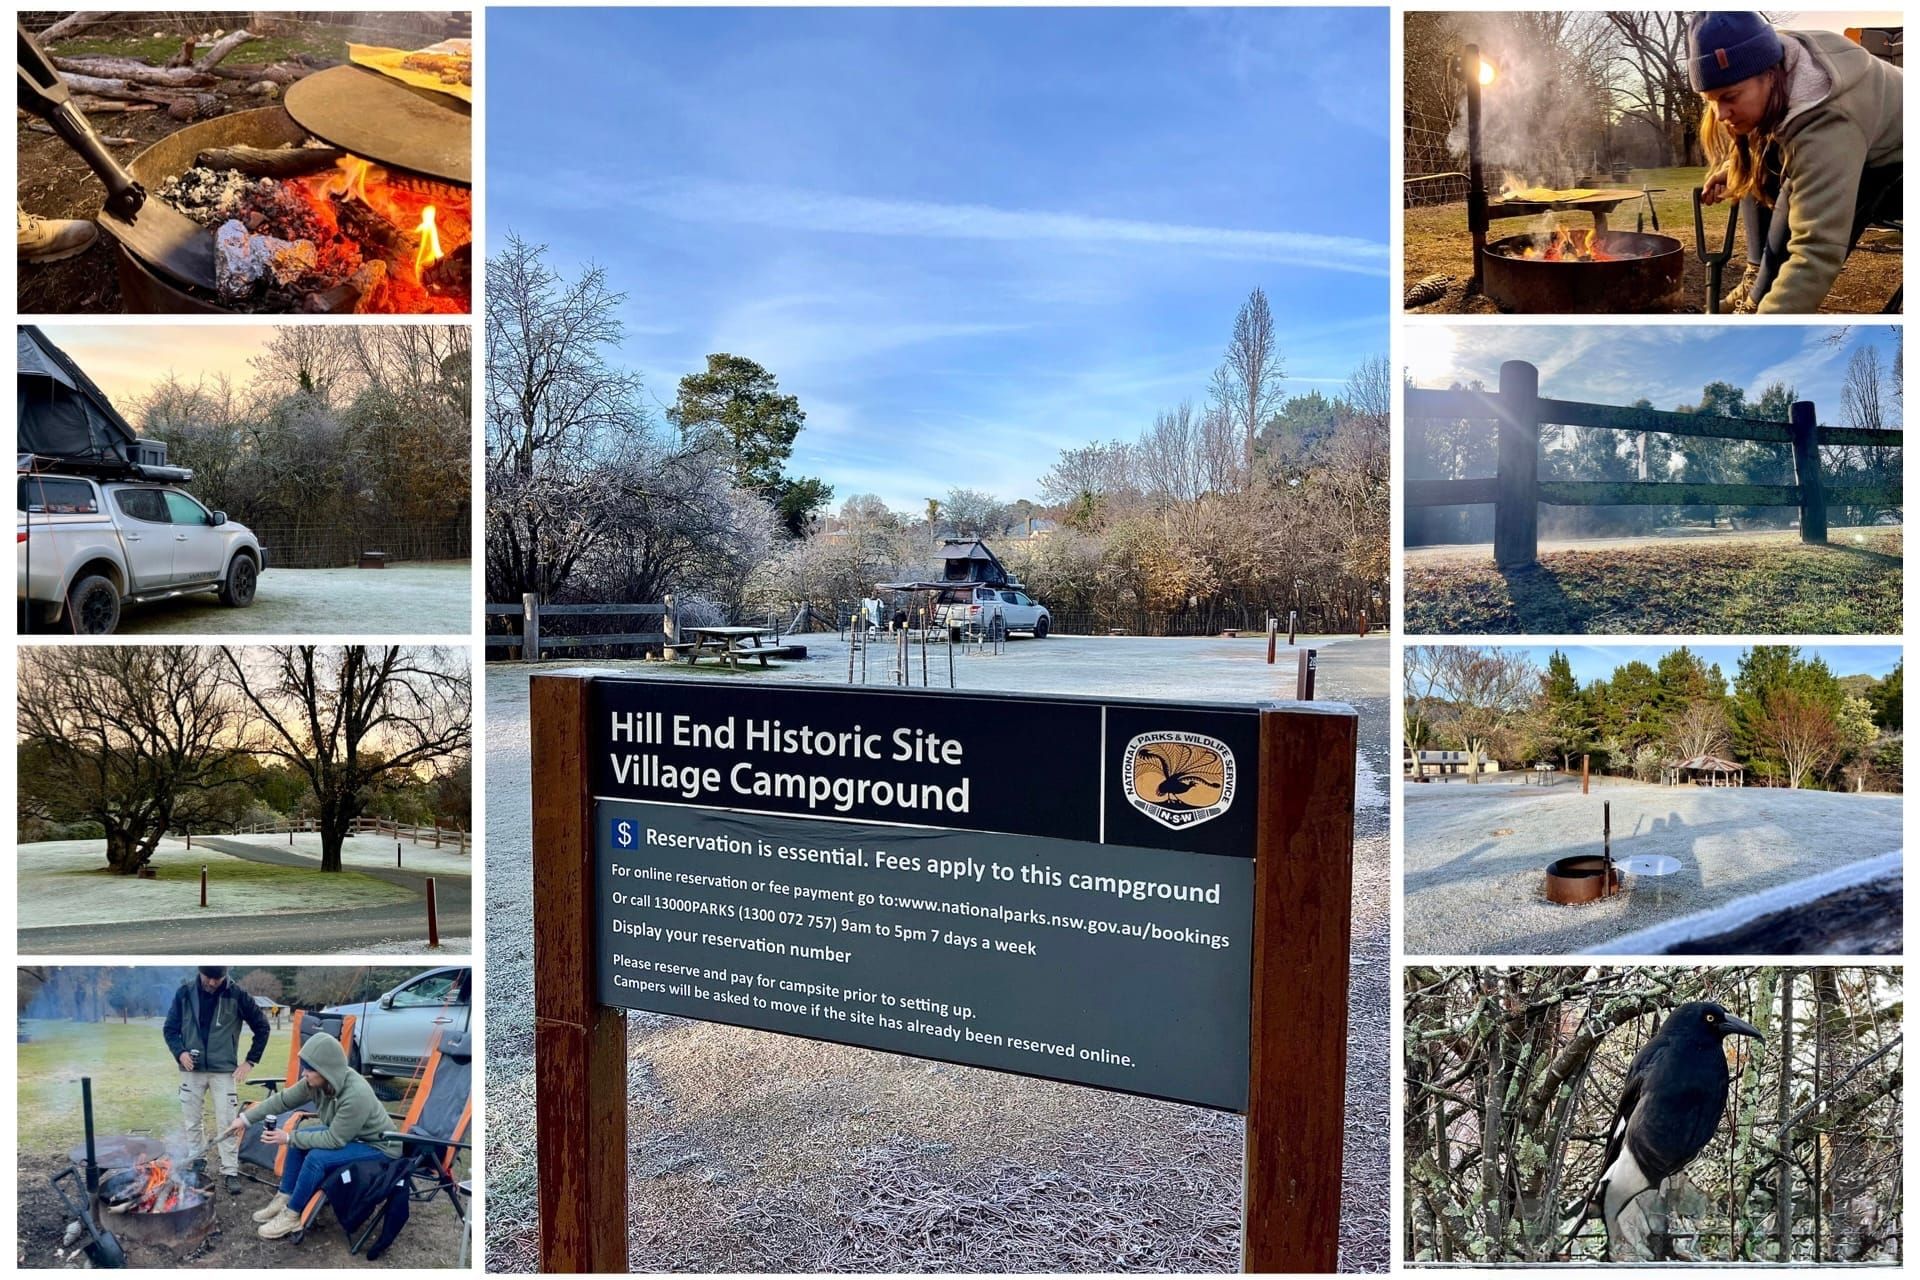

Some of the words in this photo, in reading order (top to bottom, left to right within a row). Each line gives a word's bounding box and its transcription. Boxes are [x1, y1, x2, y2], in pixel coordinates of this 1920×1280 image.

[611, 711, 662, 744] Hill
[673, 715, 735, 749] End
[747, 719, 881, 759] Historic
[892, 728, 963, 765] Site
[1125, 744, 1138, 795] NATIONAL
[1138, 733, 1173, 744] PARKS
[1175, 733, 1182, 741] &
[1184, 734, 1230, 758] WILDLIFE
[1221, 759, 1234, 803] SERVICE
[610, 753, 720, 798] Village
[730, 763, 969, 813] Campground
[612, 863, 630, 878] For
[634, 865, 673, 883] online
[676, 870, 747, 890] reservation
[751, 880, 764, 892] or
[769, 881, 790, 896] fee
[794, 885, 854, 905] payment
[858, 892, 874, 906] go
[646, 828, 751, 854] Reservation
[758, 840, 771, 857] is
[778, 843, 868, 868] essential.
[876, 851, 920, 872] Fees
[927, 855, 985, 882] apply
[992, 863, 1014, 882] to
[1021, 864, 1062, 887] this
[1069, 872, 1221, 904] campground
[612, 892, 628, 904] Or
[630, 893, 651, 908] call
[654, 896, 735, 918] 13000PARKS
[738, 907, 775, 924] (1300
[779, 911, 804, 926] 072
[807, 914, 837, 933] 757)
[841, 919, 871, 935] 9am
[875, 922, 890, 937] to
[894, 925, 926, 943] 5pm
[931, 929, 940, 943] 7
[944, 930, 978, 950] days
[981, 939, 990, 949] a
[995, 939, 1037, 956] week
[613, 920, 662, 942] Display
[666, 928, 698, 944] your
[702, 933, 786, 955] reservation
[790, 942, 851, 964] number
[613, 954, 651, 971] Please
[655, 961, 700, 978] reserve
[703, 965, 727, 981] and
[731, 971, 753, 988] pay
[757, 974, 775, 989] for
[779, 978, 840, 999] campsite
[843, 987, 877, 1004] prior
[881, 992, 896, 1006] to
[899, 995, 949, 1018] setting
[953, 1005, 977, 1020] up.
[614, 975, 666, 993] Campers
[669, 982, 691, 998] will
[695, 986, 710, 1001] be
[713, 990, 749, 1007] asked
[753, 995, 767, 1009] to
[771, 1001, 807, 1015] move
[811, 1002, 820, 1018] if
[824, 1005, 847, 1021] the
[850, 1009, 875, 1025] site
[879, 1013, 903, 1030] has
[907, 1017, 961, 1042] already
[966, 1027, 1003, 1046] been
[1007, 1036, 1075, 1057] reserved
[1080, 1046, 1136, 1067] online.
